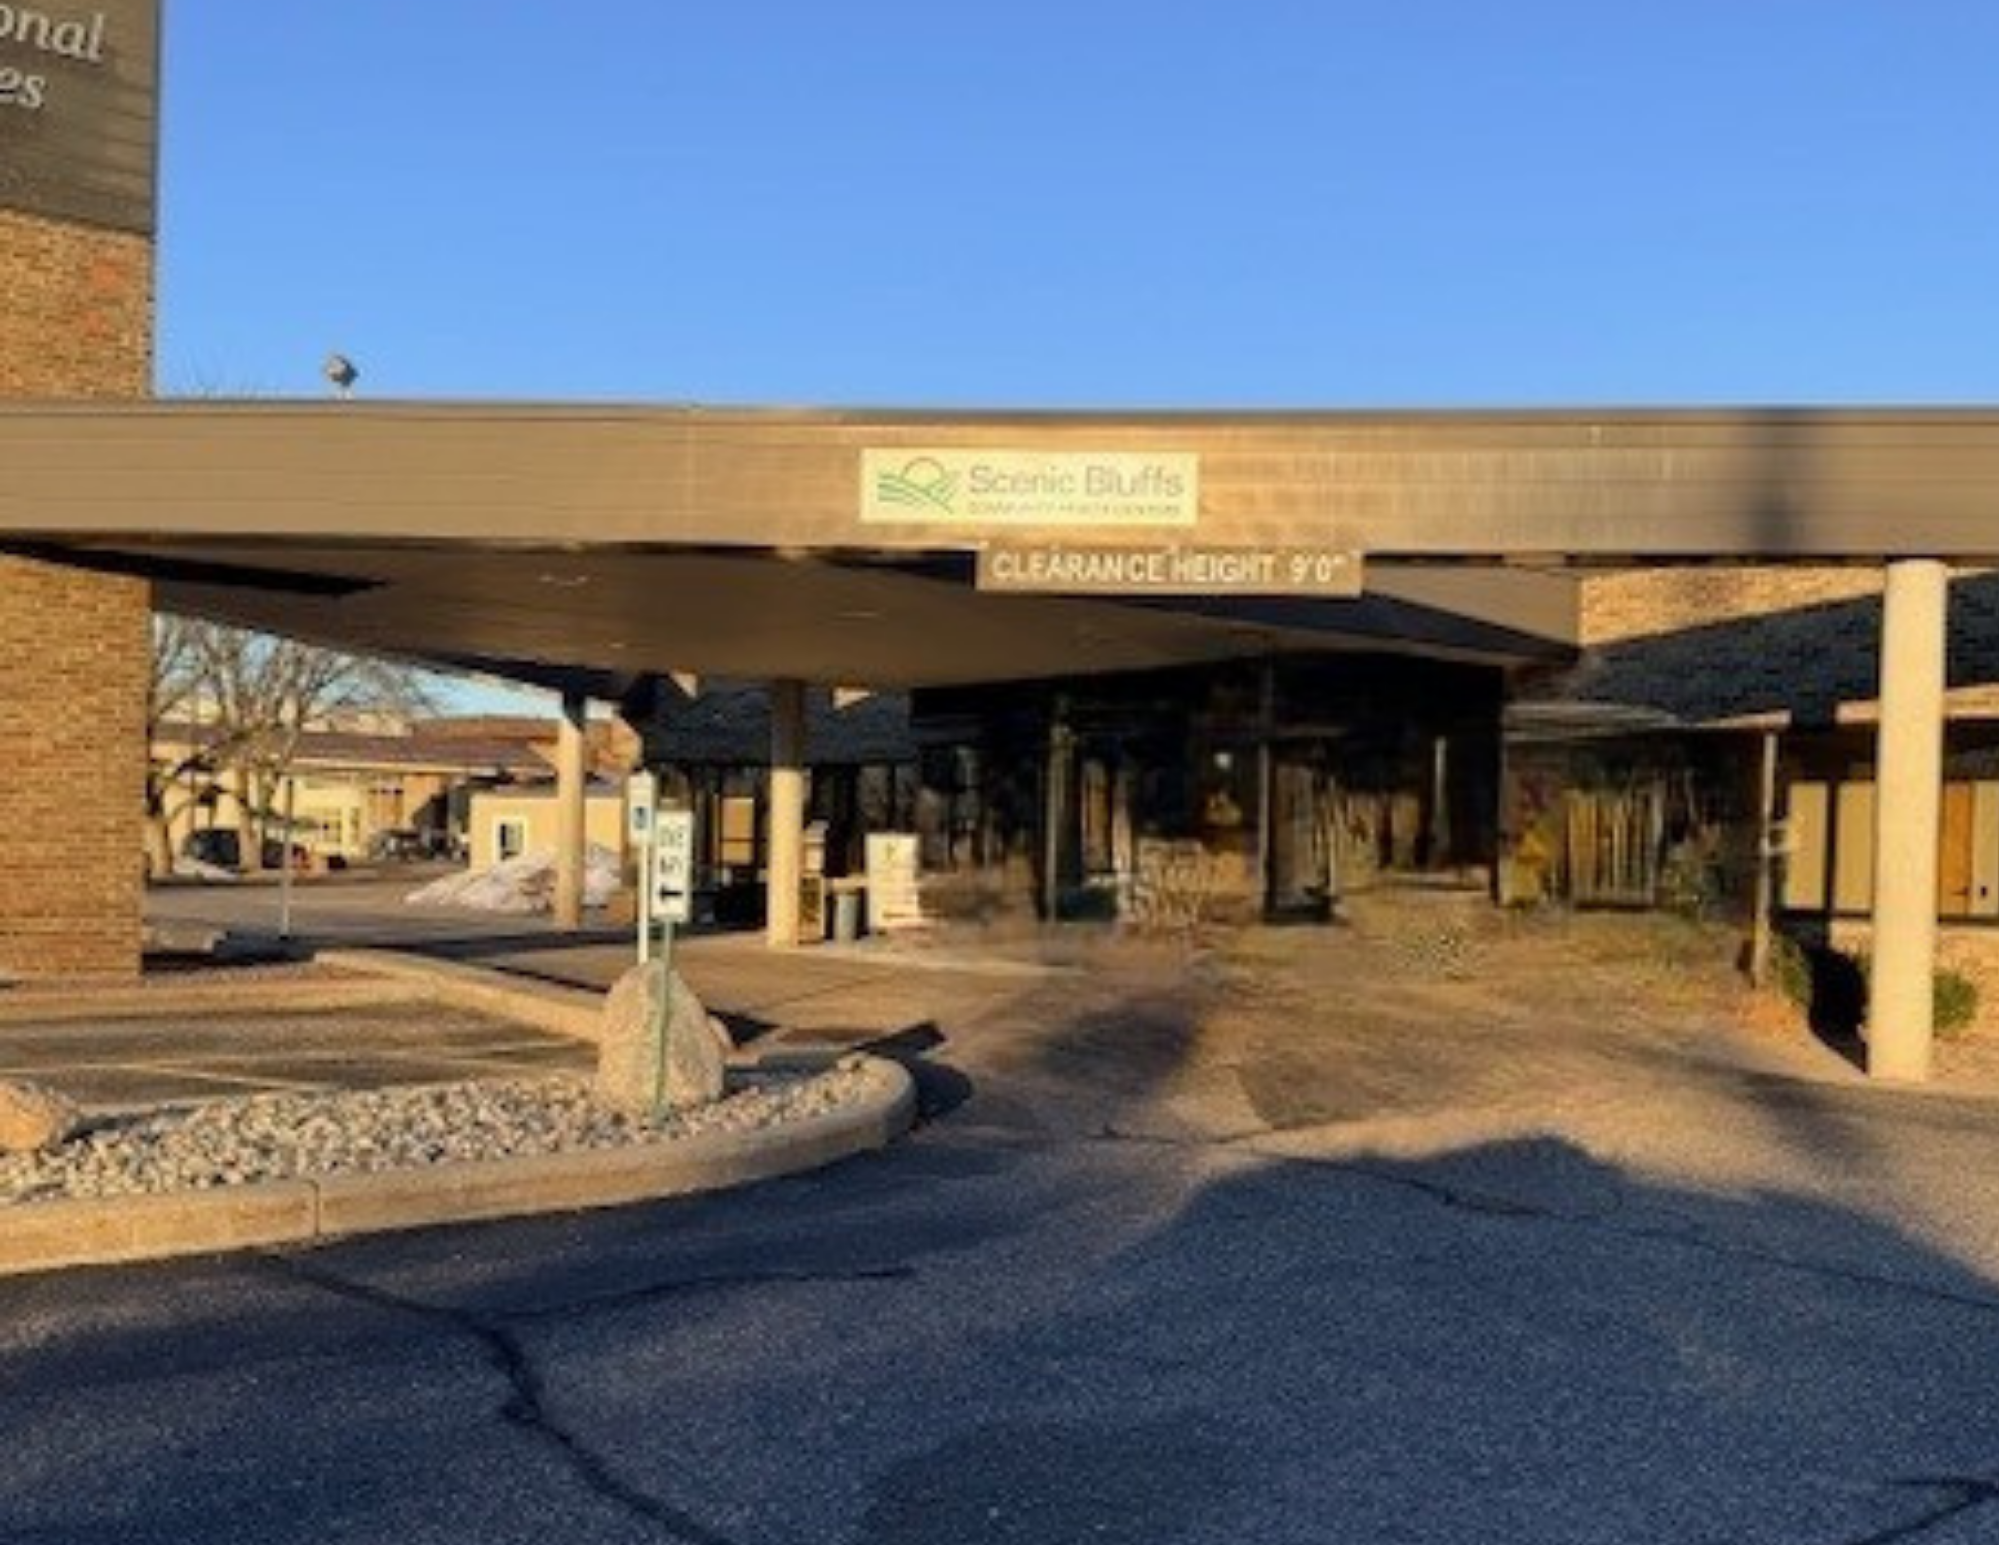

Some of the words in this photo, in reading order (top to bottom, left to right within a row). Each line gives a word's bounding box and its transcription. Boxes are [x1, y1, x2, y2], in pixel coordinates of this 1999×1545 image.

[968, 464, 1076, 495] Scenic
[1085, 465, 1185, 498] Bluffs
[992, 552, 1167, 583] CLEARANCE
[1170, 552, 1275, 584] HEIGHT
